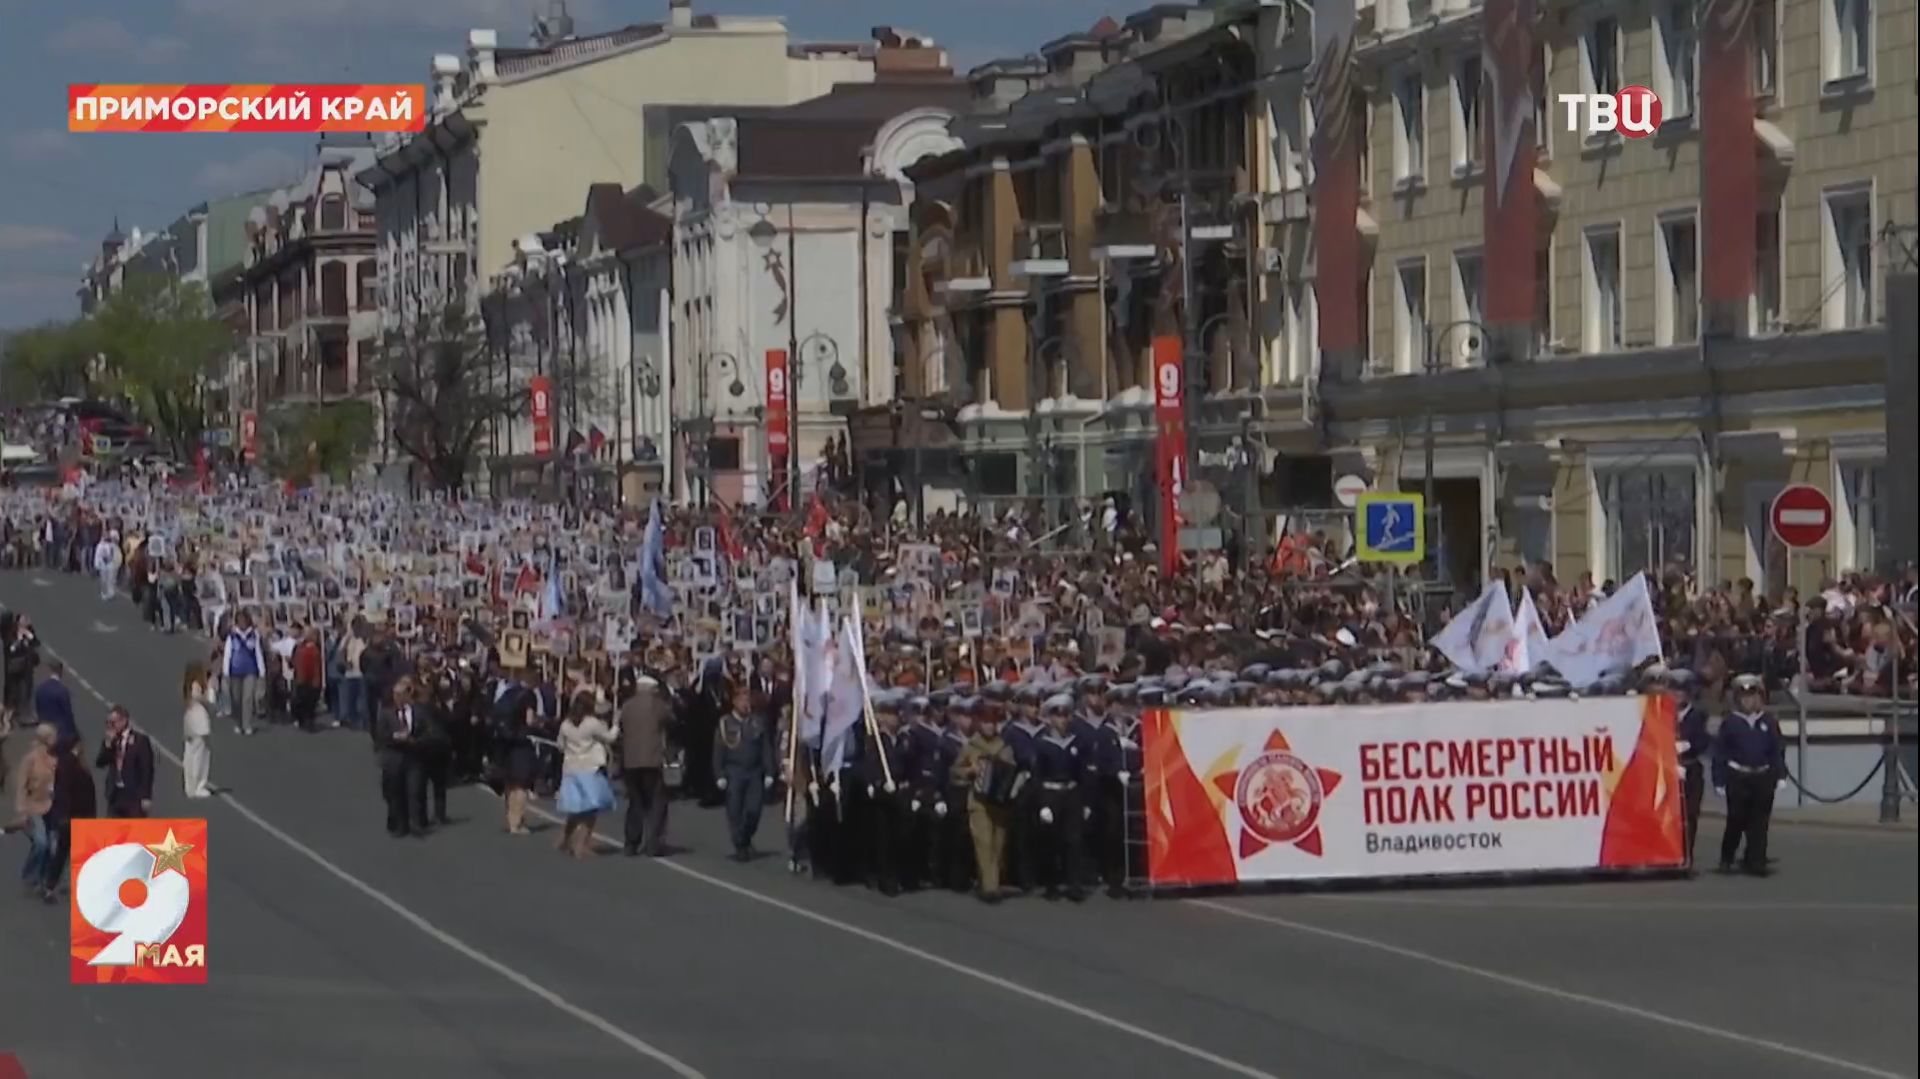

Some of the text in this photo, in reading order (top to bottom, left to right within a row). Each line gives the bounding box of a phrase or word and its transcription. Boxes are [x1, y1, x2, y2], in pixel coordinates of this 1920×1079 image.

[769, 367, 784, 392] 9
[1159, 363, 1179, 398] 9
[1359, 726, 1614, 782] БЕССМЕРТНЫЙ
[1363, 780, 1600, 825] ПОЛК РОССИИ
[1366, 832, 1502, 854] Владивосток
